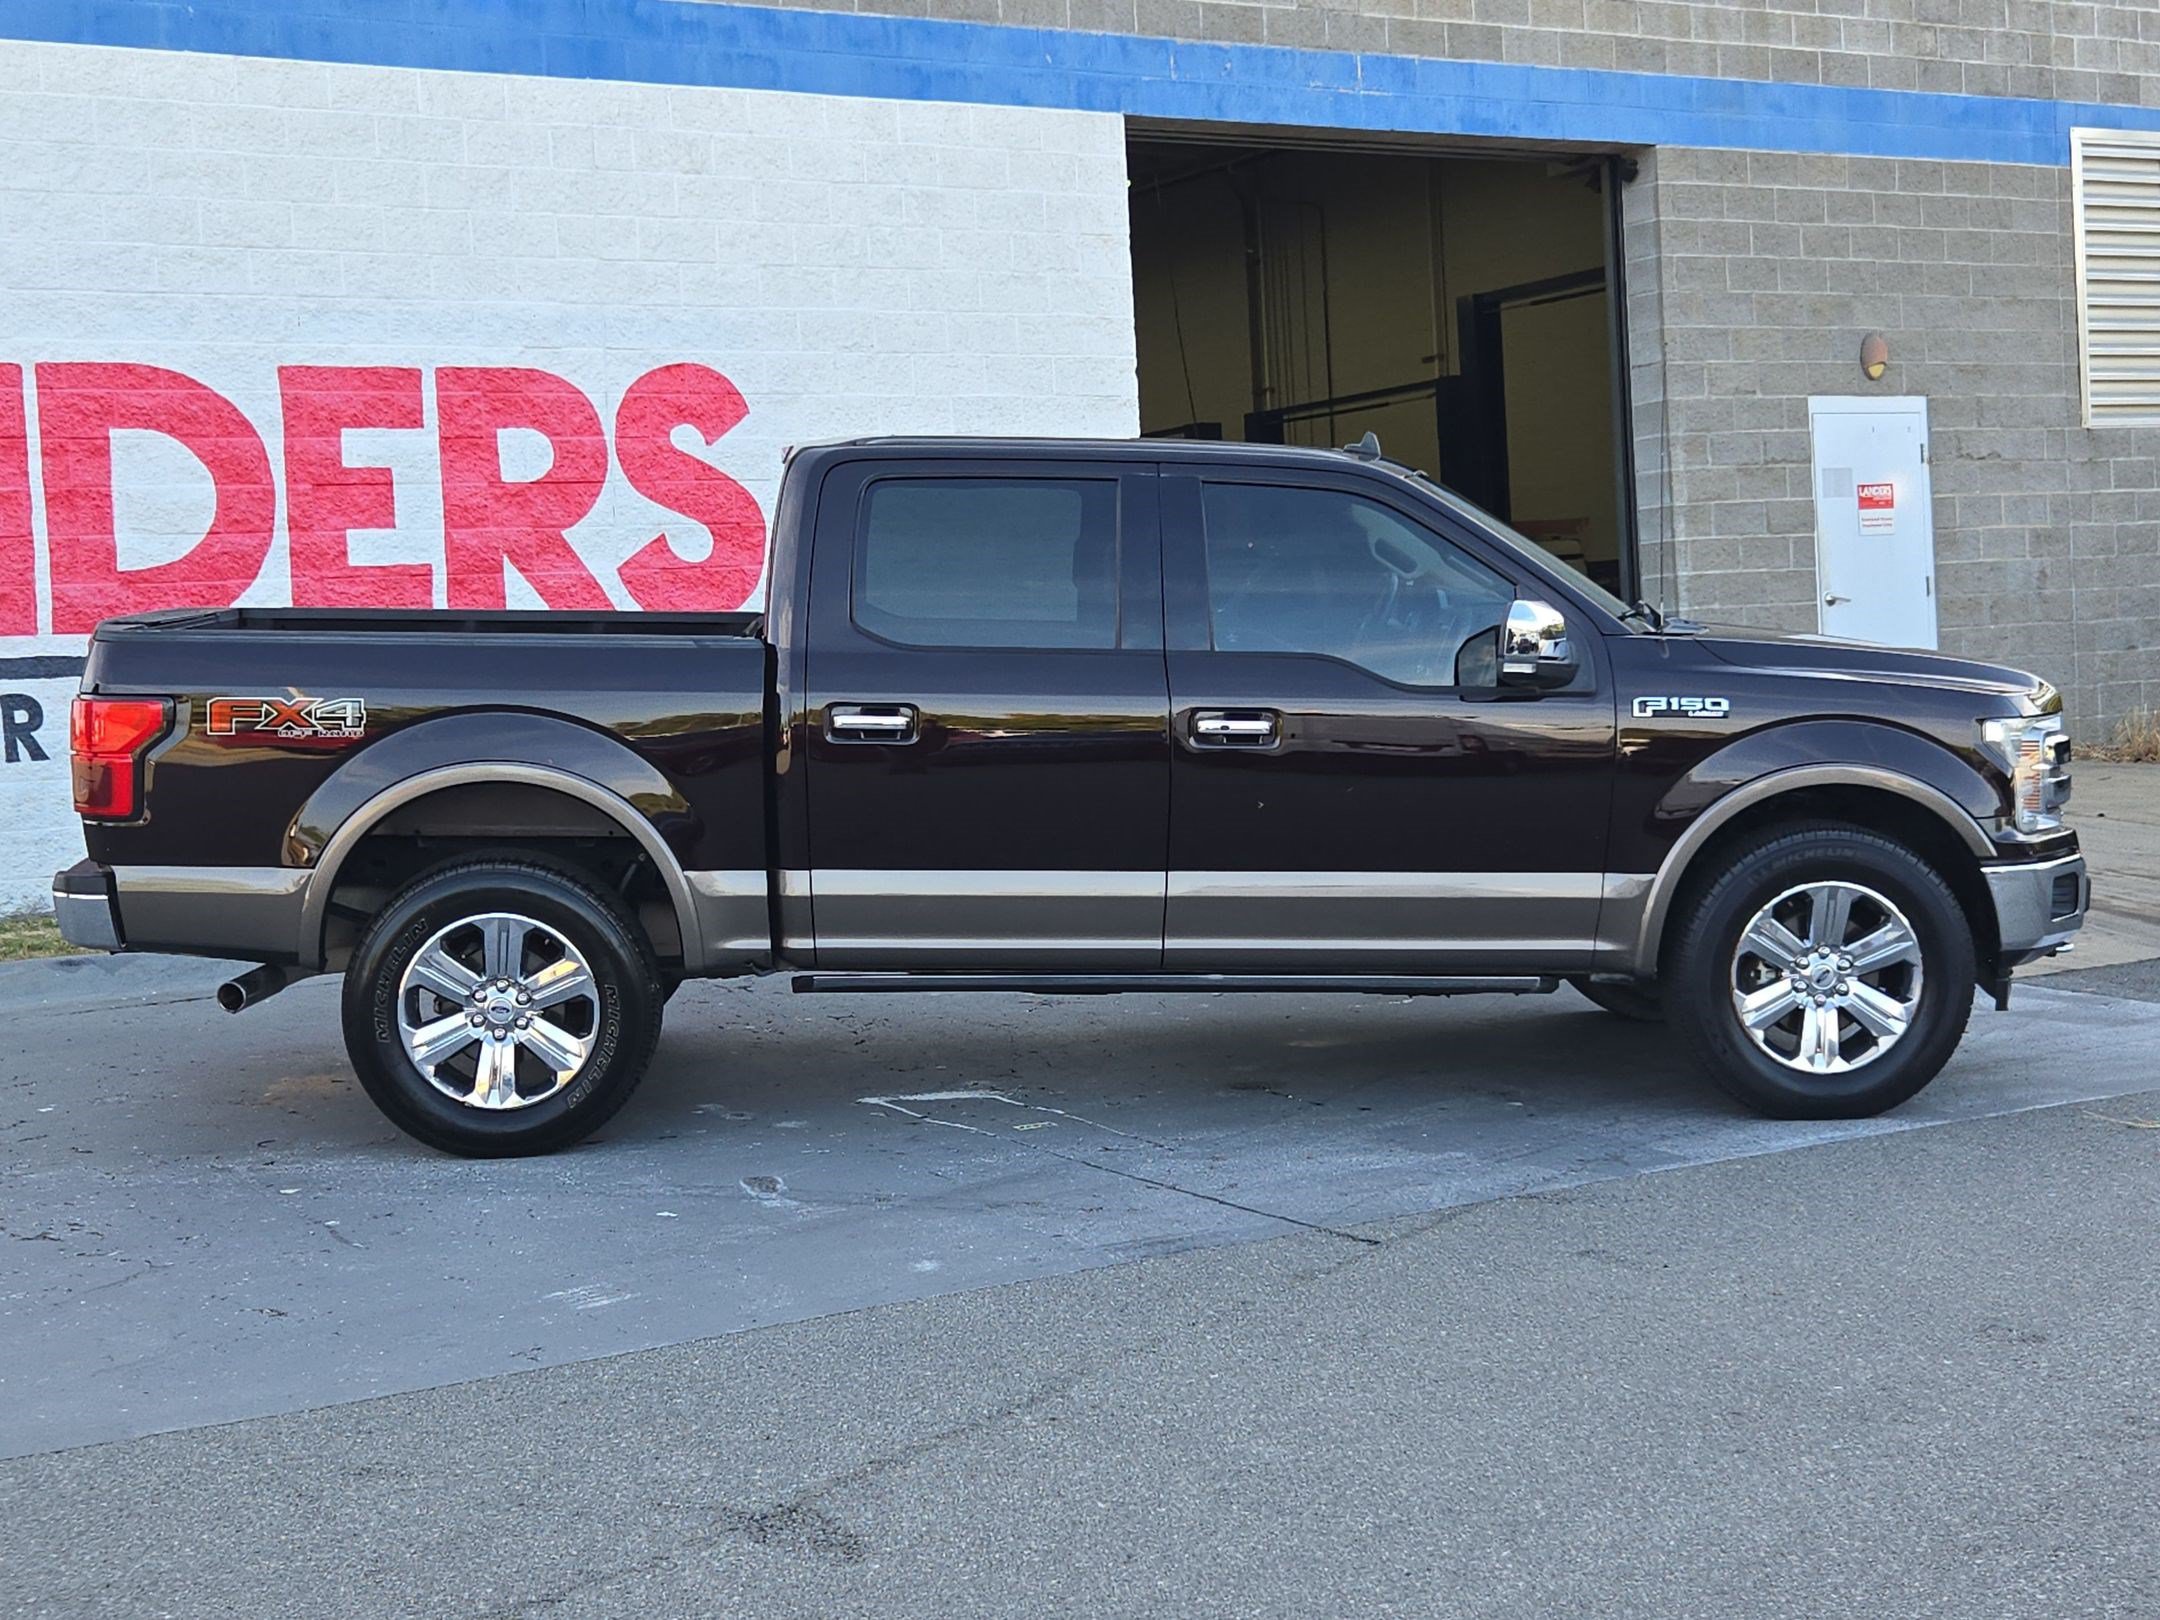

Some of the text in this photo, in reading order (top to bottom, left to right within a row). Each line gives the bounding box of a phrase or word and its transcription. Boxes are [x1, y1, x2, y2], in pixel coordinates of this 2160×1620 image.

[0, 362, 767, 636] DERS
[206, 697, 366, 735] FX4
[1632, 696, 1730, 718] F150
[374, 918, 429, 1044] MICHELIN
[567, 983, 621, 1109] MICHELIN
